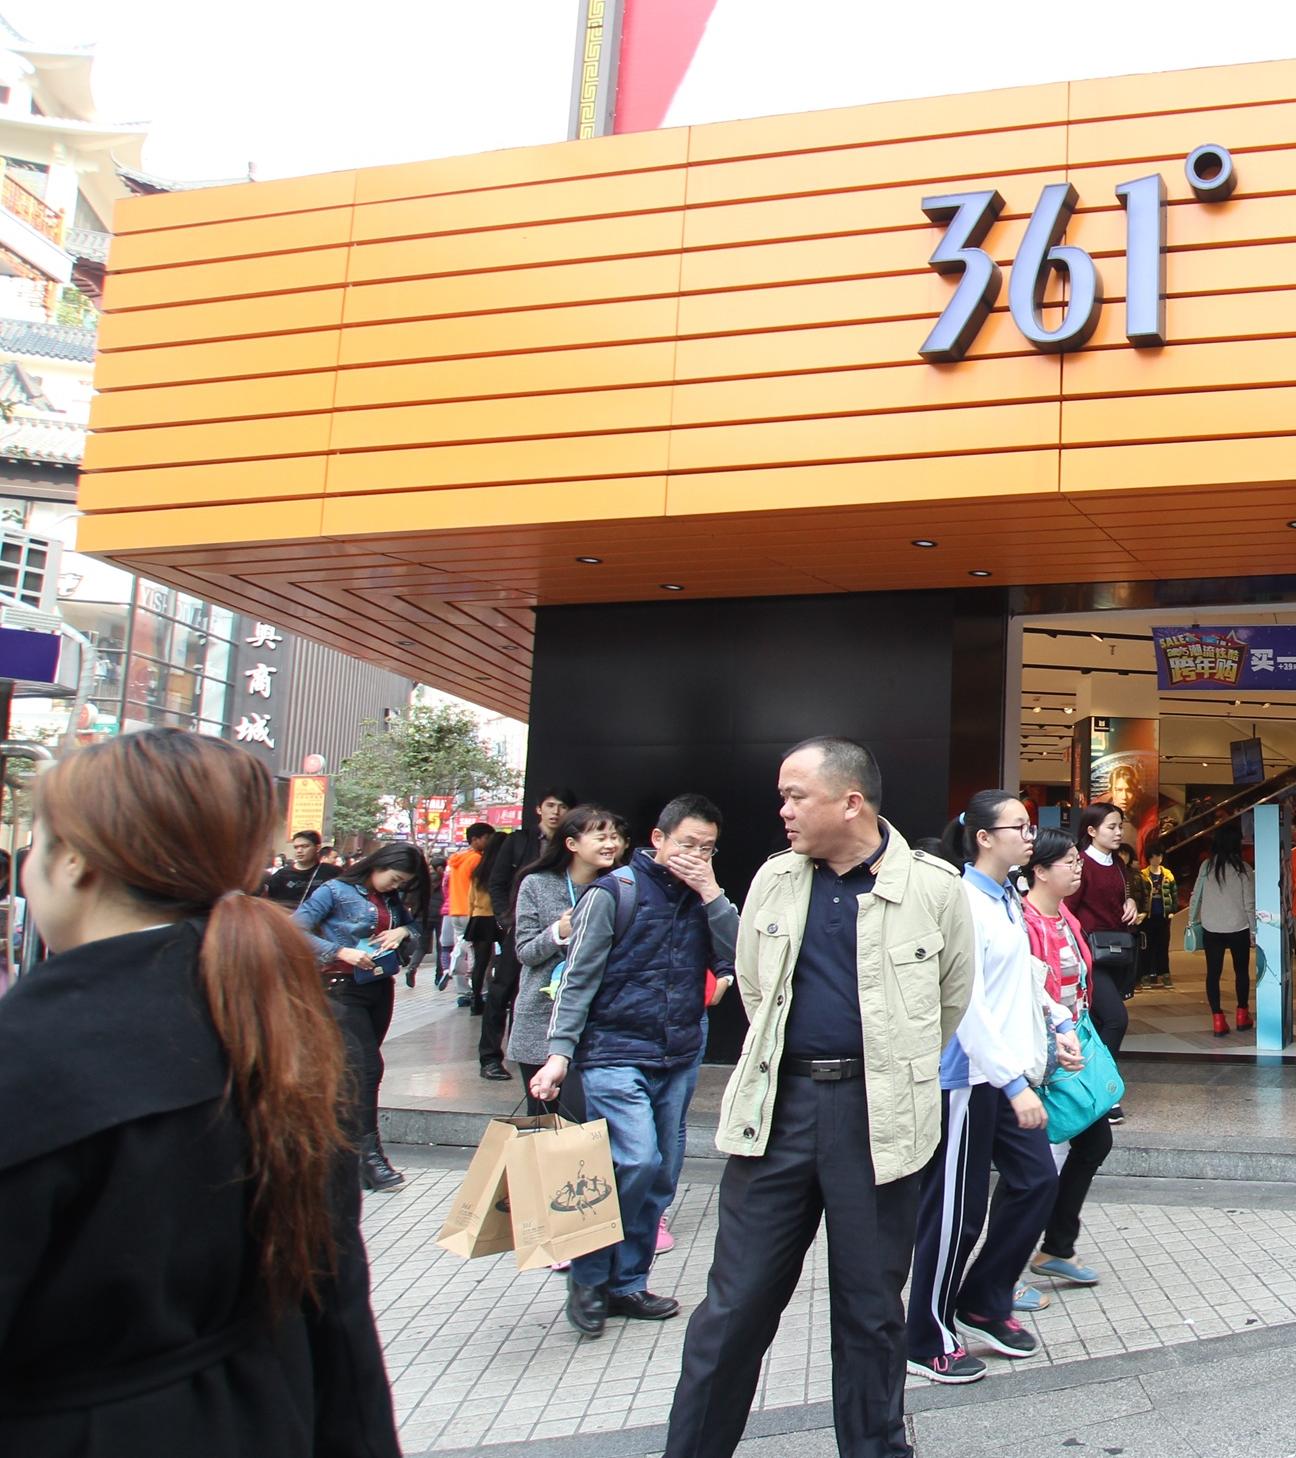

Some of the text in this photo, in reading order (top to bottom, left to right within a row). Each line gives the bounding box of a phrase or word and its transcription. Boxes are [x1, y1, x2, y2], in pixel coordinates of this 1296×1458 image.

[918, 144, 1238, 361] 361°
[1159, 635, 1186, 649] SALE
[1168, 656, 1238, 683] 跨年购
